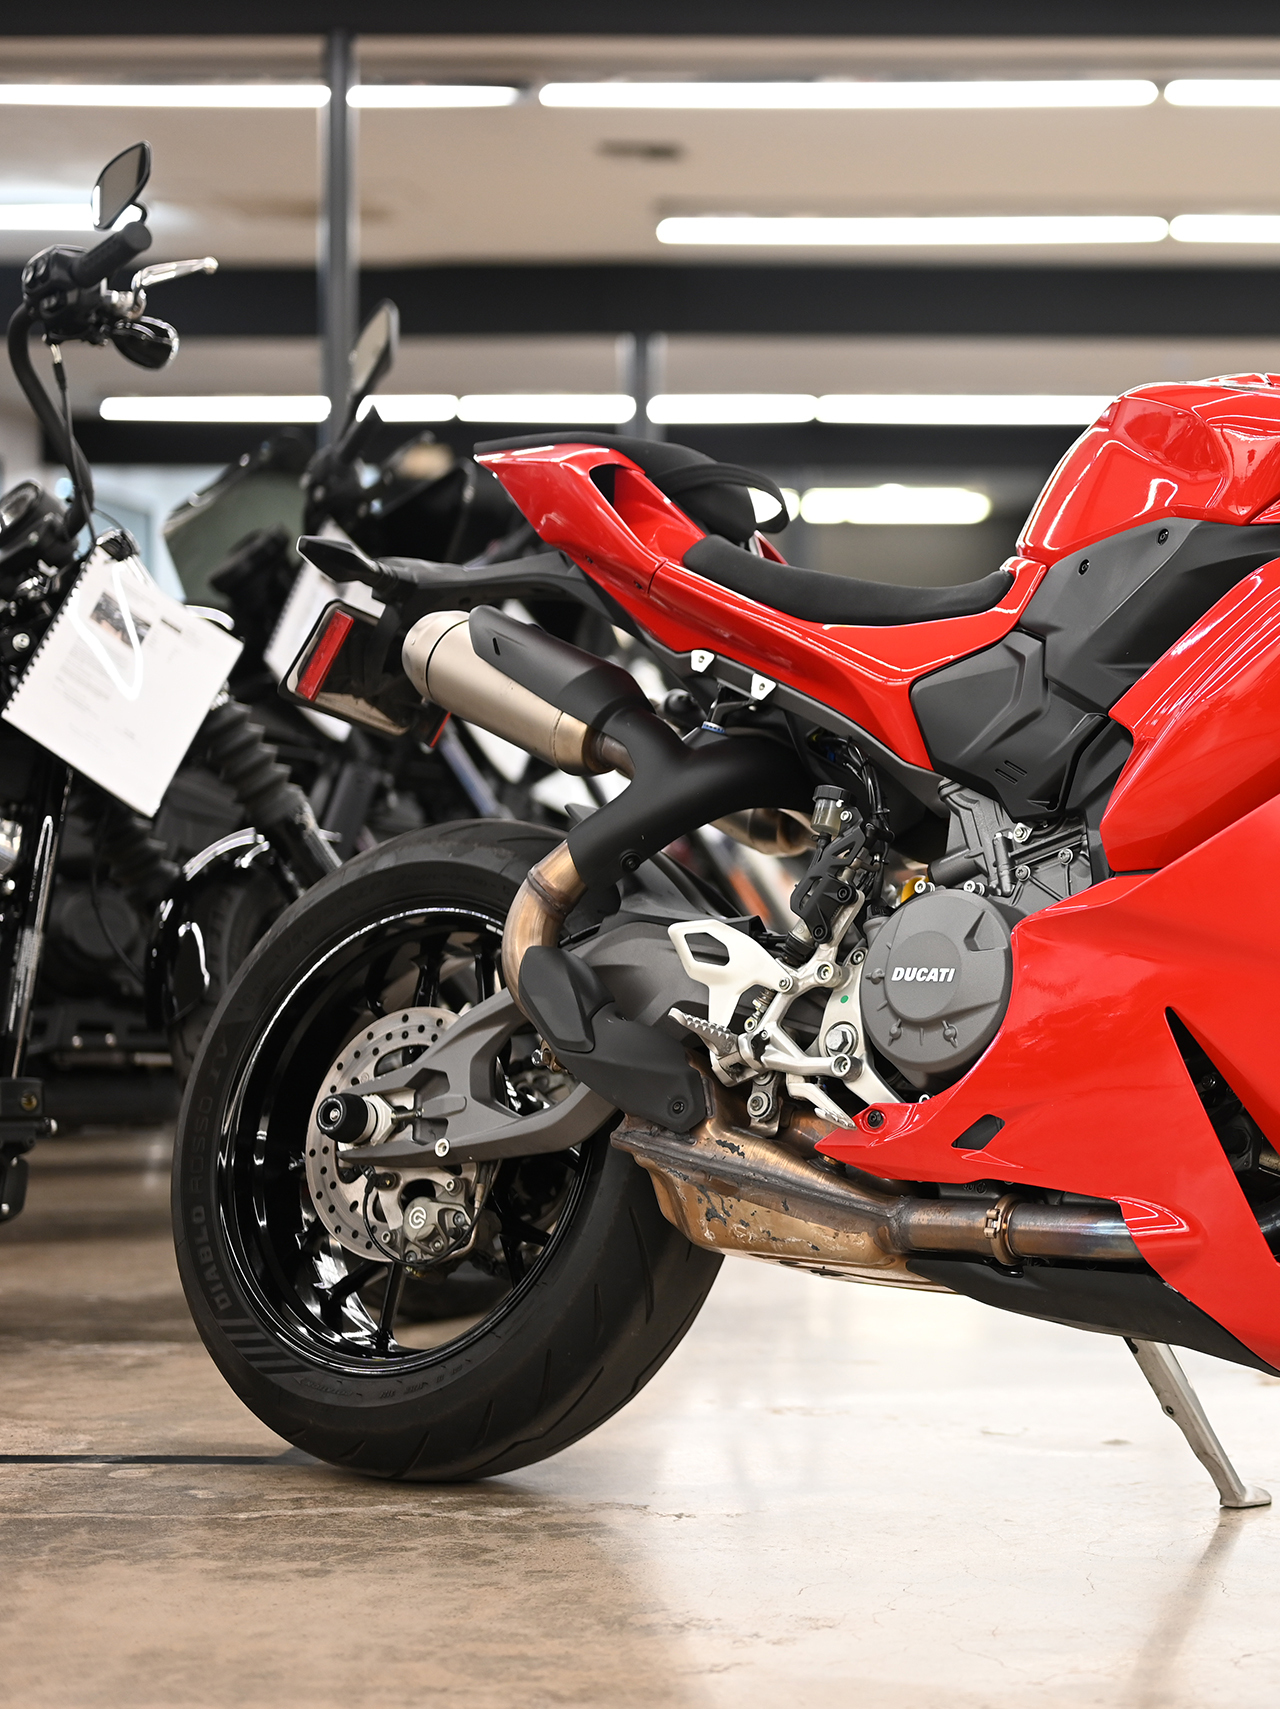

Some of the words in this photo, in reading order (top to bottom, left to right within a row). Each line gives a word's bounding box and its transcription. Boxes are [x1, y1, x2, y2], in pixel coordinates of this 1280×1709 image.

[891, 967, 955, 982] DUCATI
[190, 1095, 213, 1194] ROSSO
[192, 1205, 232, 1311] DIABLO
